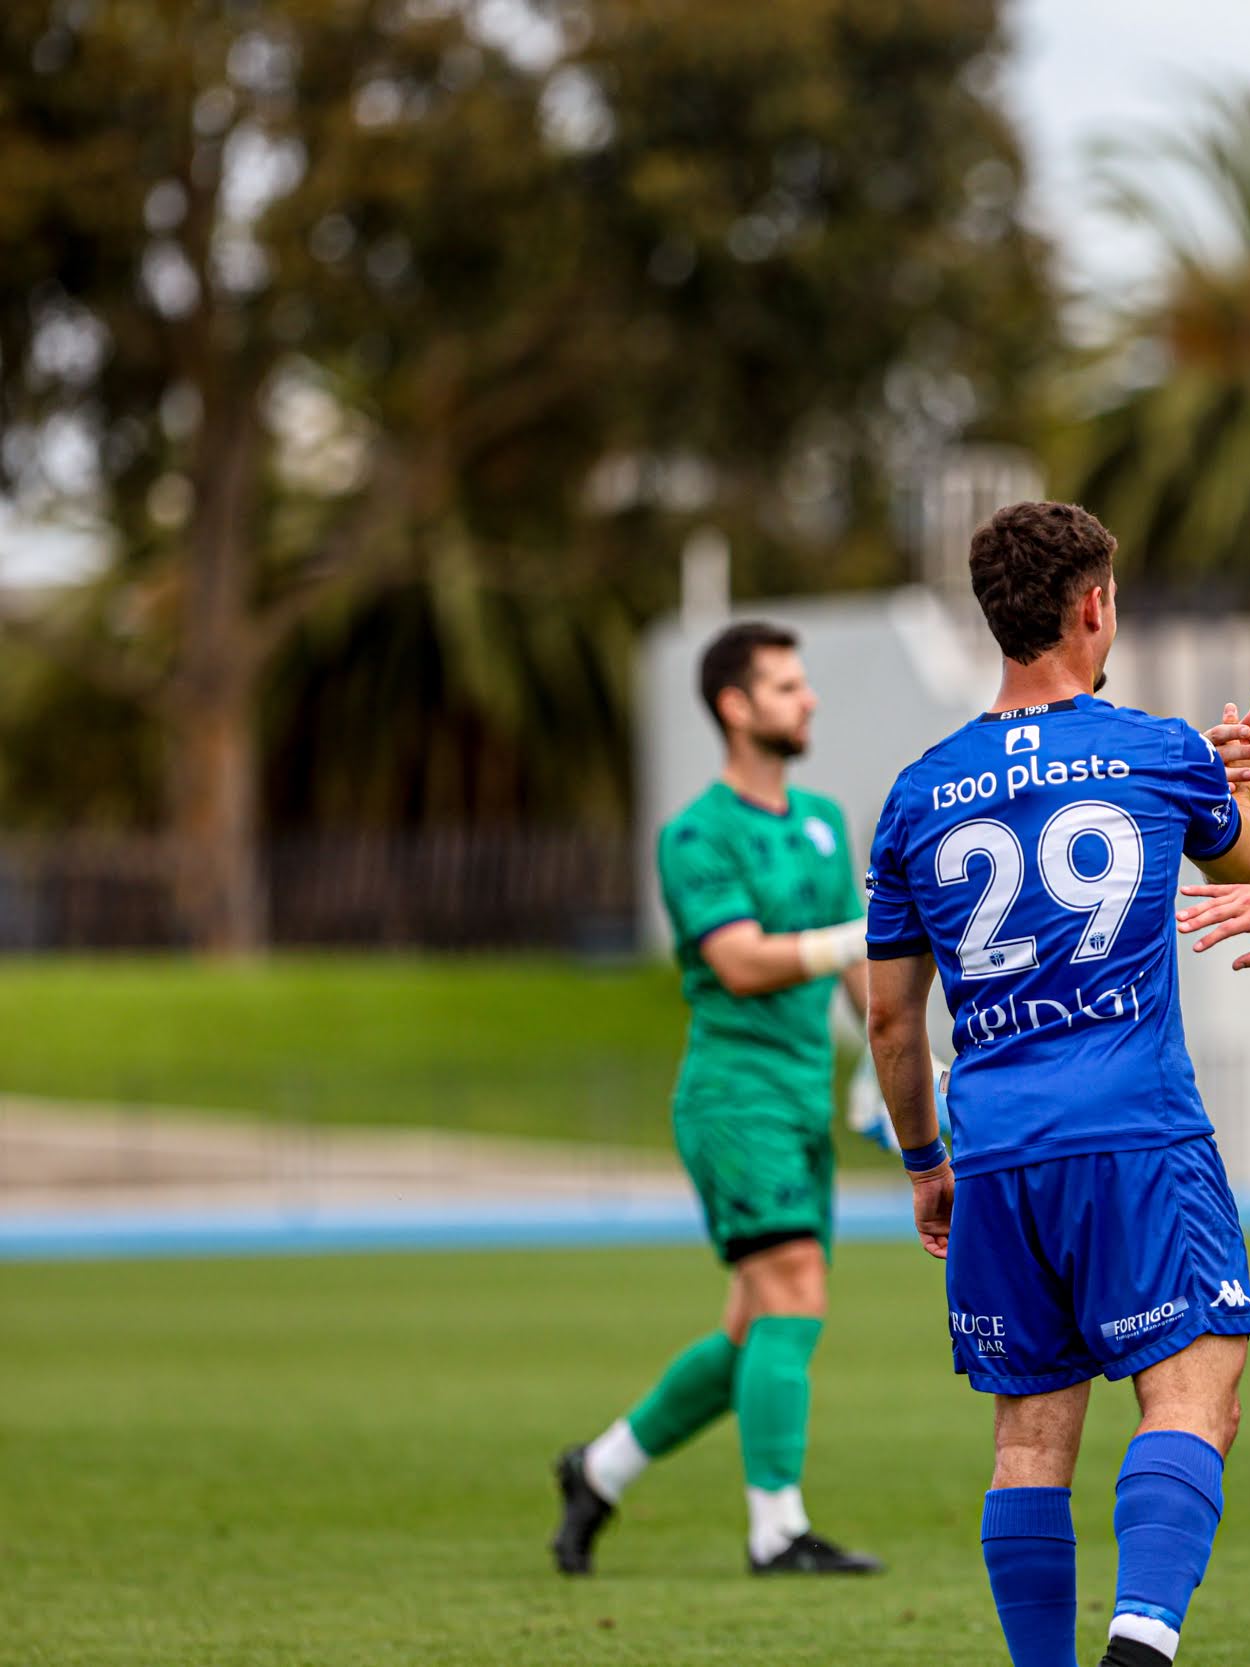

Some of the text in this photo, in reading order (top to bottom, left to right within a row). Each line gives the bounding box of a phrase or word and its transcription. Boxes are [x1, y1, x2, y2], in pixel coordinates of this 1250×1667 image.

[1000, 704, 1049, 720] EST. 1959
[932, 754, 1131, 811] 1300 plasta
[934, 799, 1144, 981] 29
[951, 1311, 1005, 1336] RUCE
[1114, 1302, 1174, 1335] FORTIGO
[978, 1339, 1006, 1353] BAR
